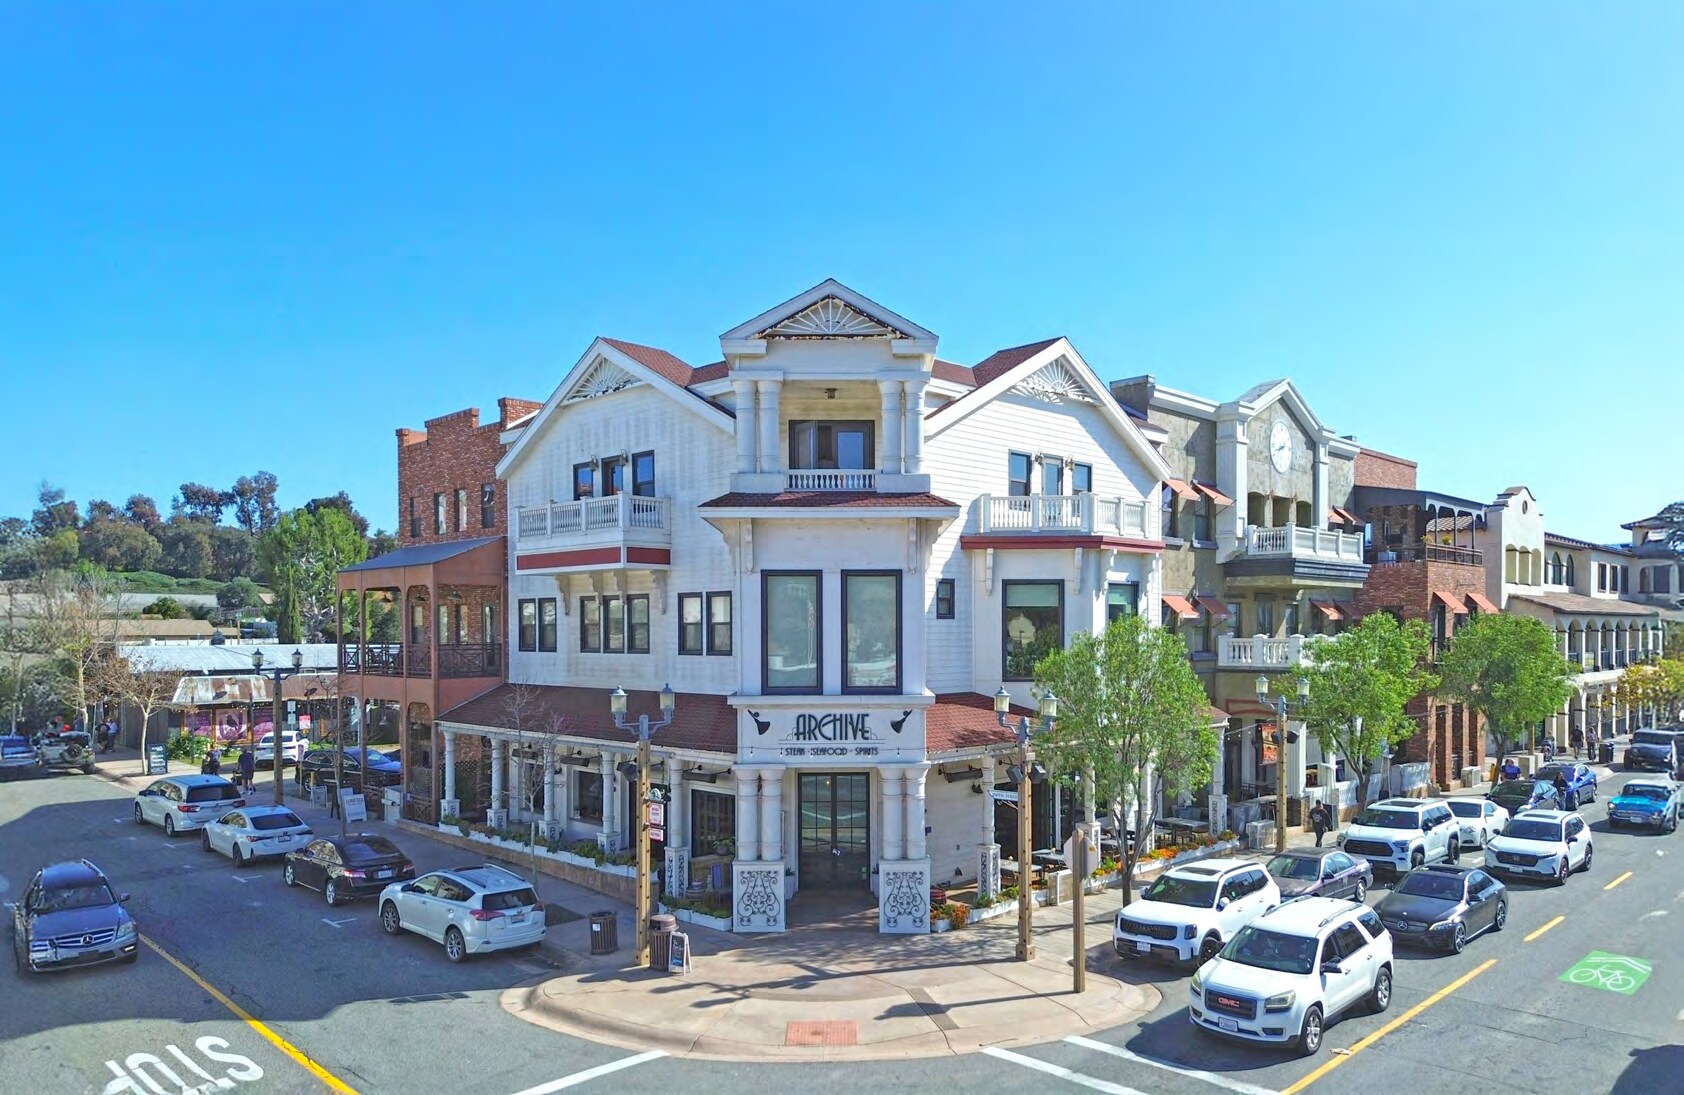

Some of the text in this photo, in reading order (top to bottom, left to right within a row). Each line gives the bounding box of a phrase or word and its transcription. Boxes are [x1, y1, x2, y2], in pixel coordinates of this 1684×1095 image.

[795, 713, 870, 741] ARCHIVE
[785, 746, 879, 756] STEAK SEAFOOD SPIRITS
[1218, 997, 1240, 1008] GMC
